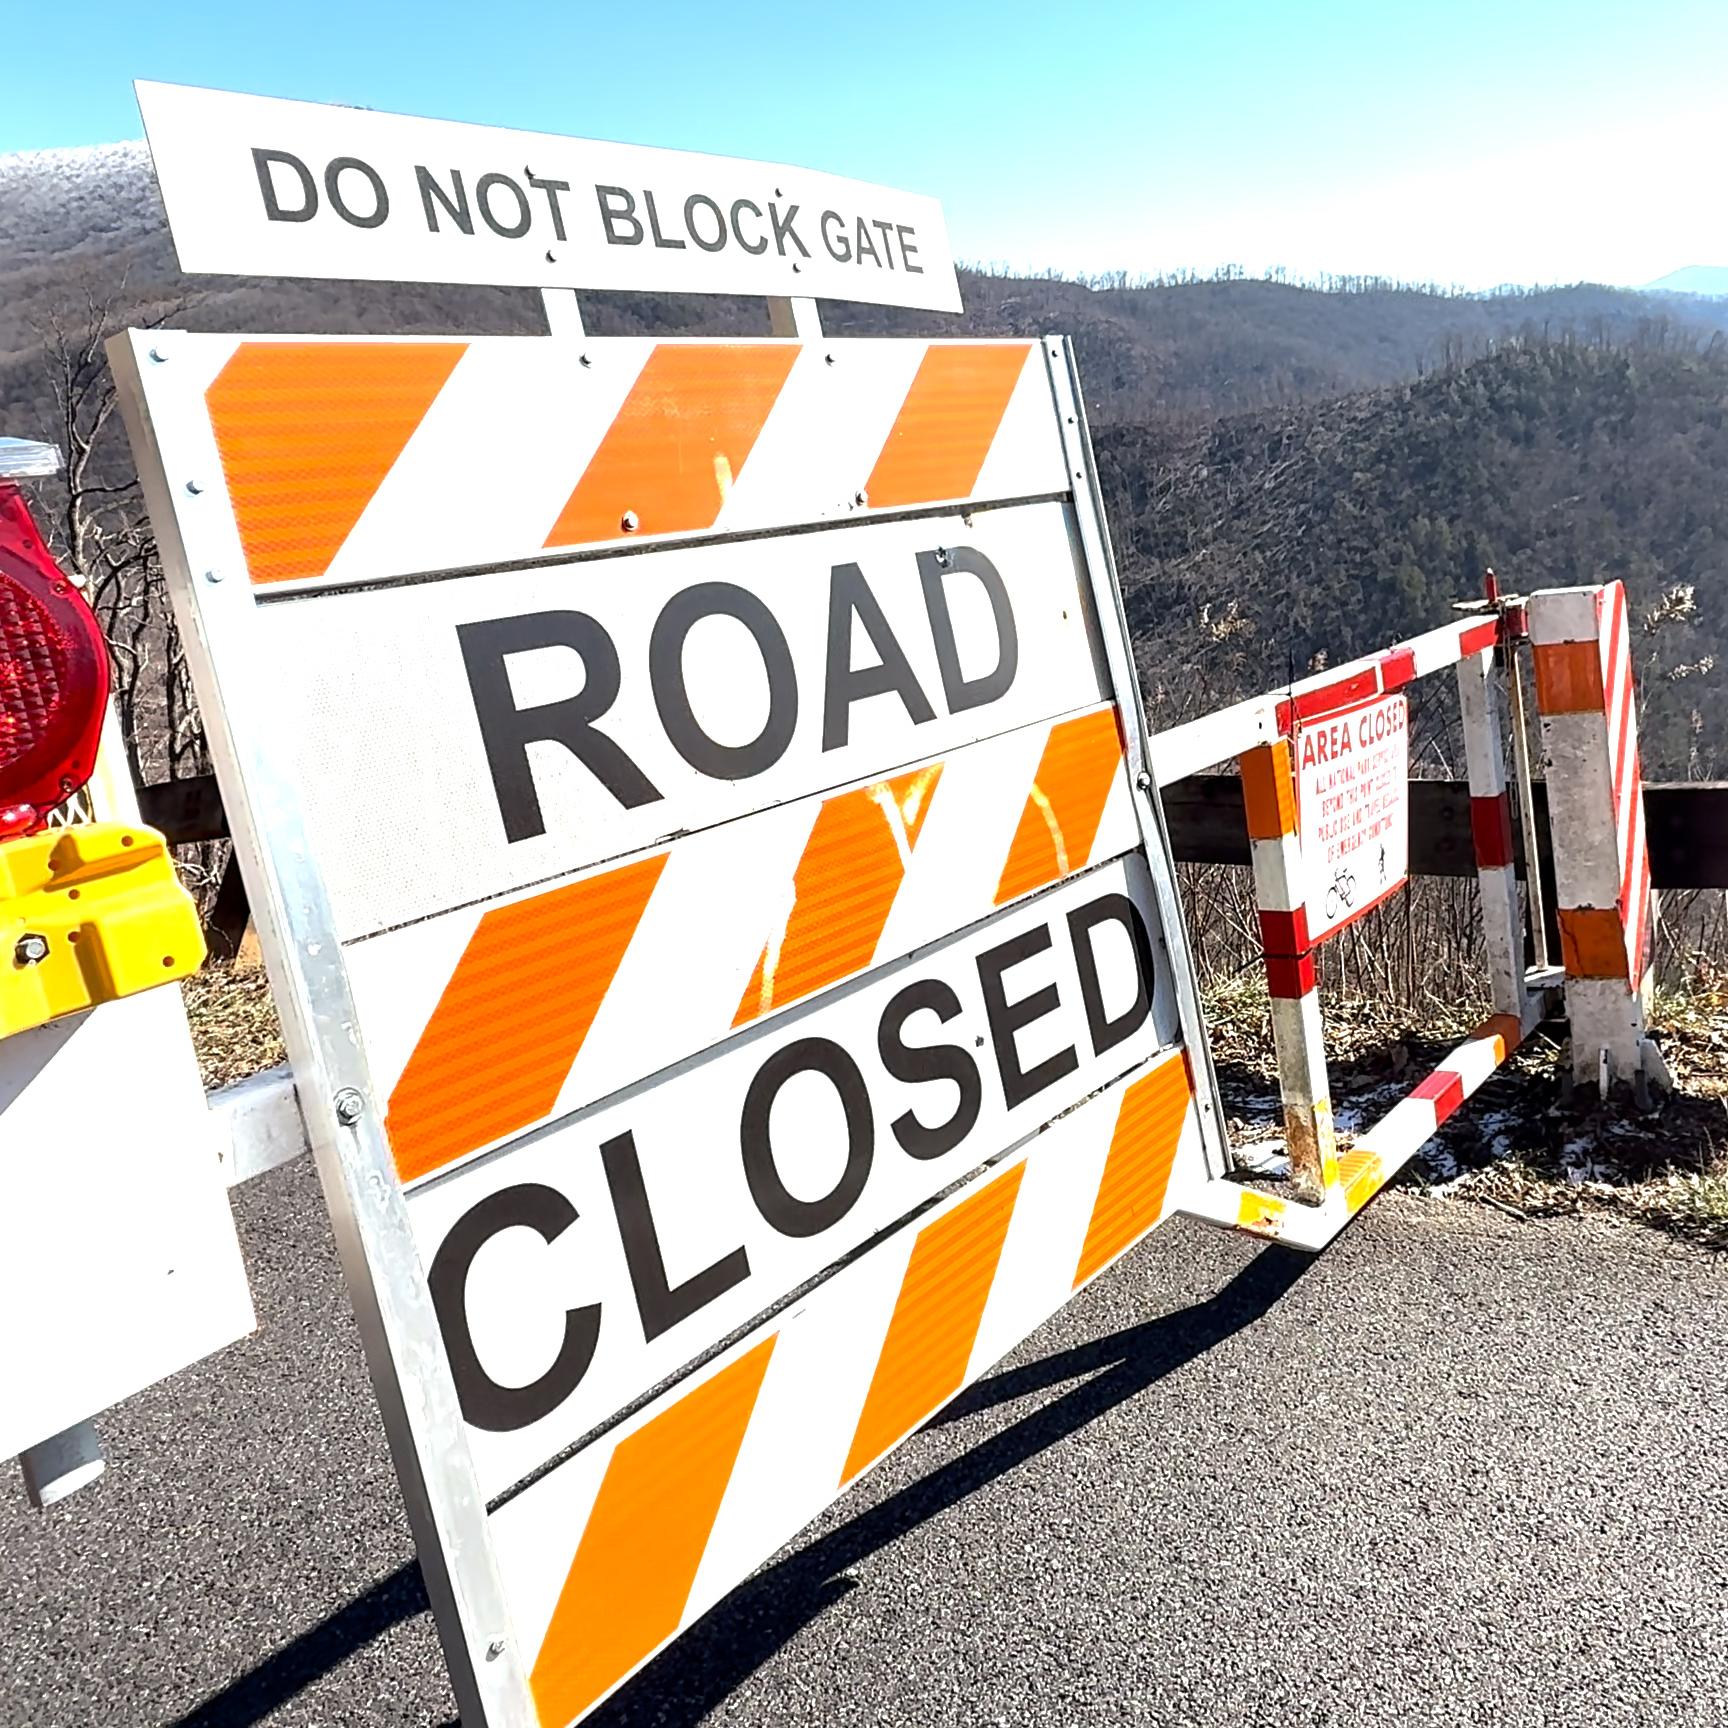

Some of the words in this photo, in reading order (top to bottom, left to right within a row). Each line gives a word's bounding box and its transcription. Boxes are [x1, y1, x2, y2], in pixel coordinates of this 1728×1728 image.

[251, 147, 390, 229] DO
[414, 165, 570, 242] NOT
[595, 184, 811, 258] BLOCK
[821, 210, 924, 274] GATE
[456, 545, 1019, 845] ROAD
[1302, 722, 1352, 770] AREA
[1359, 699, 1405, 749] CLOSED
[427, 892, 1157, 1433] CLOSED
